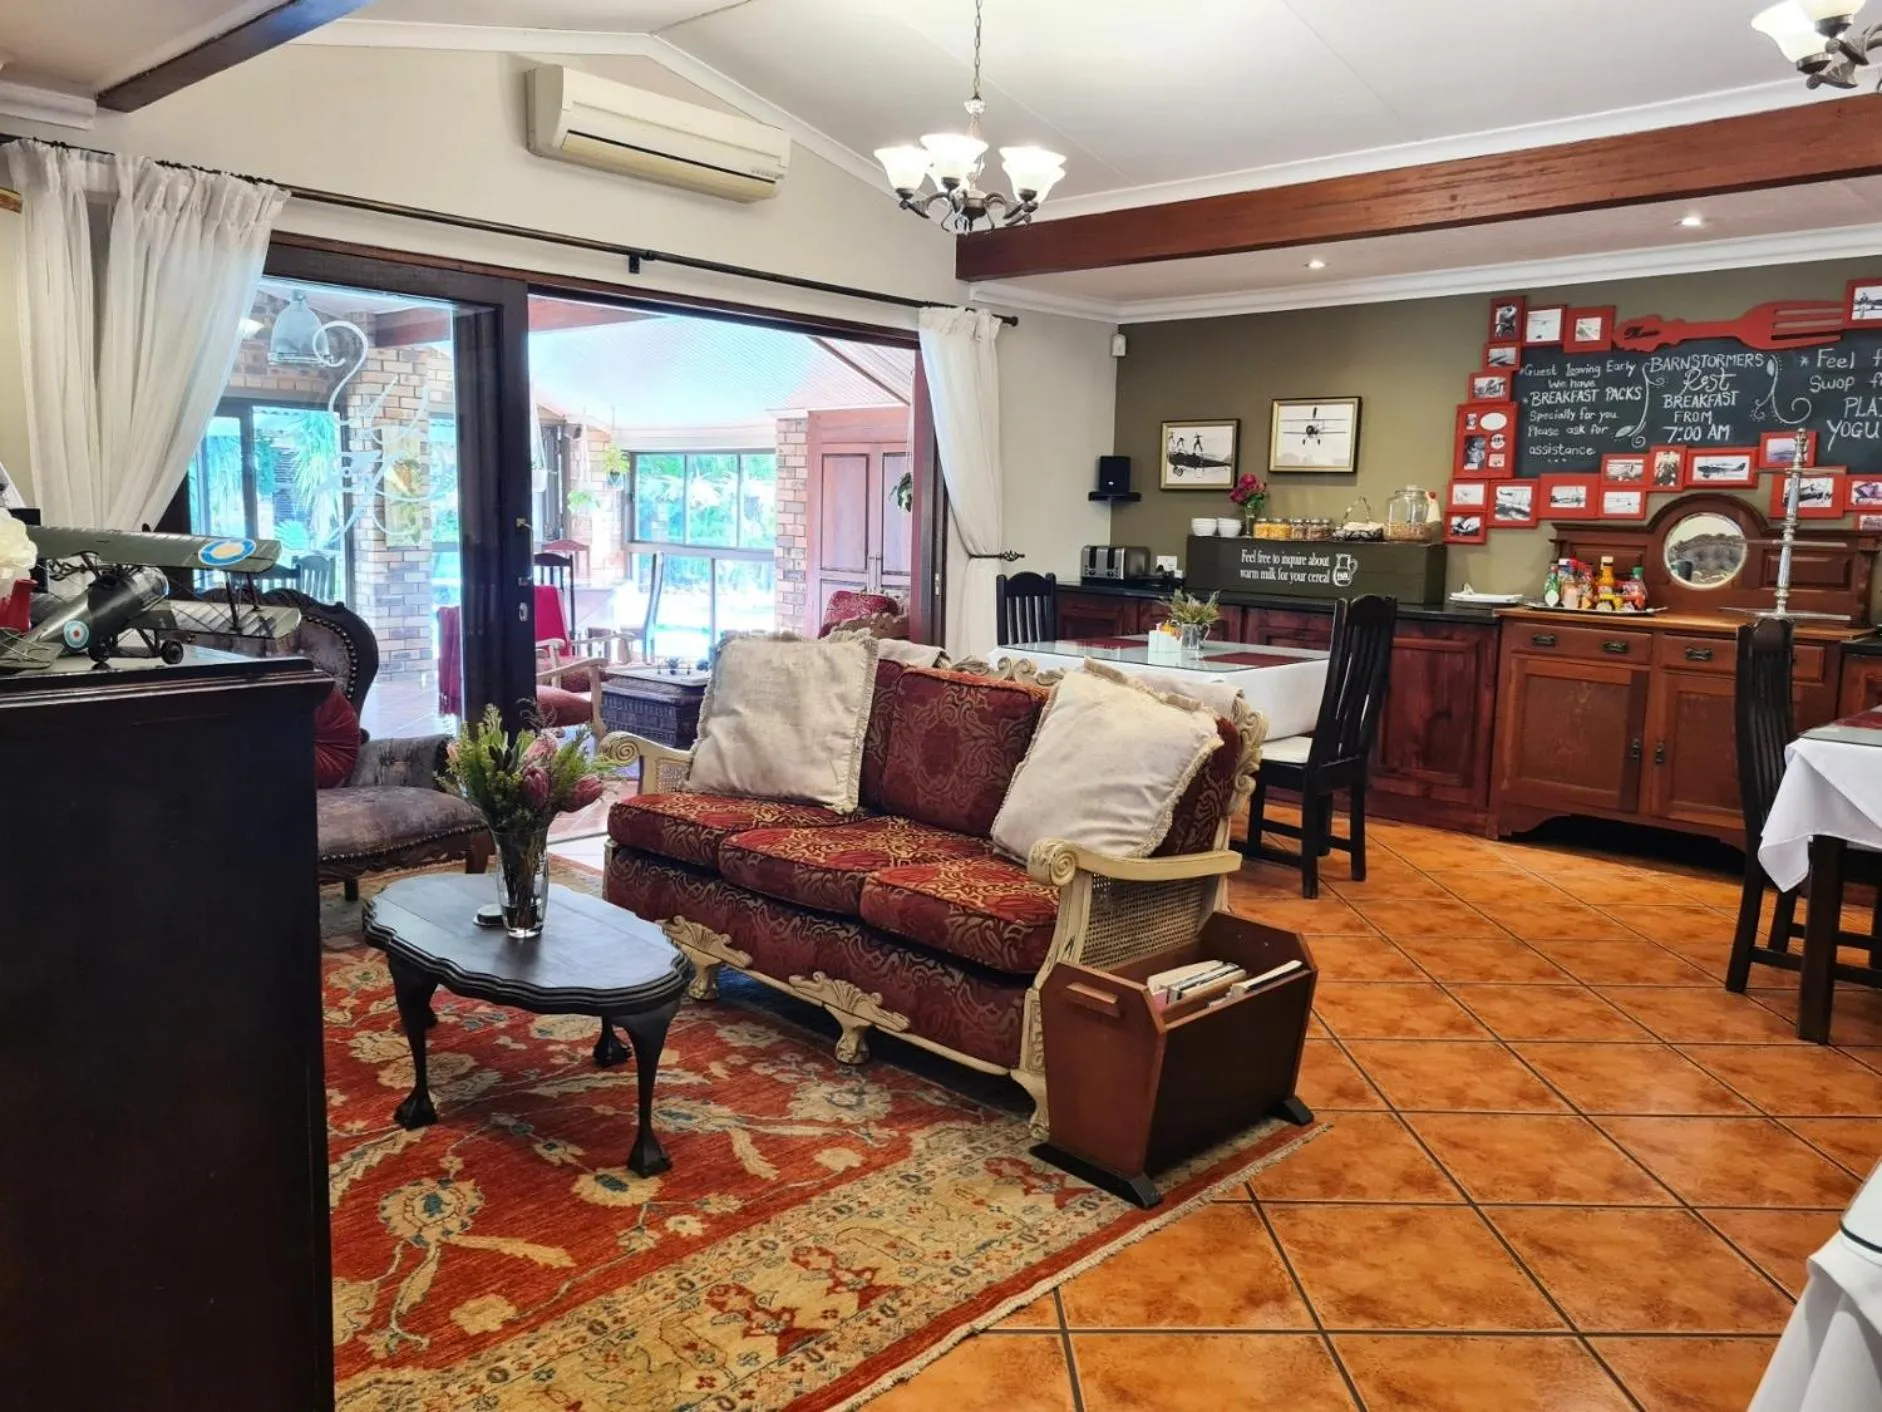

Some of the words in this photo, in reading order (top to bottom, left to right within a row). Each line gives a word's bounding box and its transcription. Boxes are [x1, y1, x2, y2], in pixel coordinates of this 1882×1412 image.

[1650, 353, 1764, 373] BARNSTORMERS
[1817, 348, 1855, 369] Feel
[1525, 364, 1557, 376] Guest
[1606, 359, 1636, 377] Early
[1570, 379, 1596, 388] have
[1680, 367, 1736, 395] Rest
[1809, 375, 1855, 393] Swop
[1530, 389, 1600, 407] BREAKFAST
[1605, 386, 1643, 402] PACKS
[1662, 390, 1740, 408] BREAKFAST
[1529, 408, 1576, 423] Specially
[1580, 406, 1596, 420] for
[1674, 411, 1713, 425] FROM
[1528, 425, 1559, 437] Please
[1566, 425, 1585, 435] ask
[1590, 424, 1609, 434] for
[1662, 426, 1701, 444] 7:00
[1707, 424, 1731, 441] AM
[1529, 443, 1596, 456] assistance
[1241, 549, 1257, 563] Feel
[1258, 550, 1271, 563] free
[1272, 553, 1280, 564] to
[1281, 551, 1307, 568] inquire
[1308, 552, 1330, 567] about
[1240, 569, 1259, 579] warm
[1261, 567, 1276, 580] milk
[1278, 567, 1288, 580] for
[1289, 571, 1307, 584] your
[1308, 569, 1330, 583] cereal
